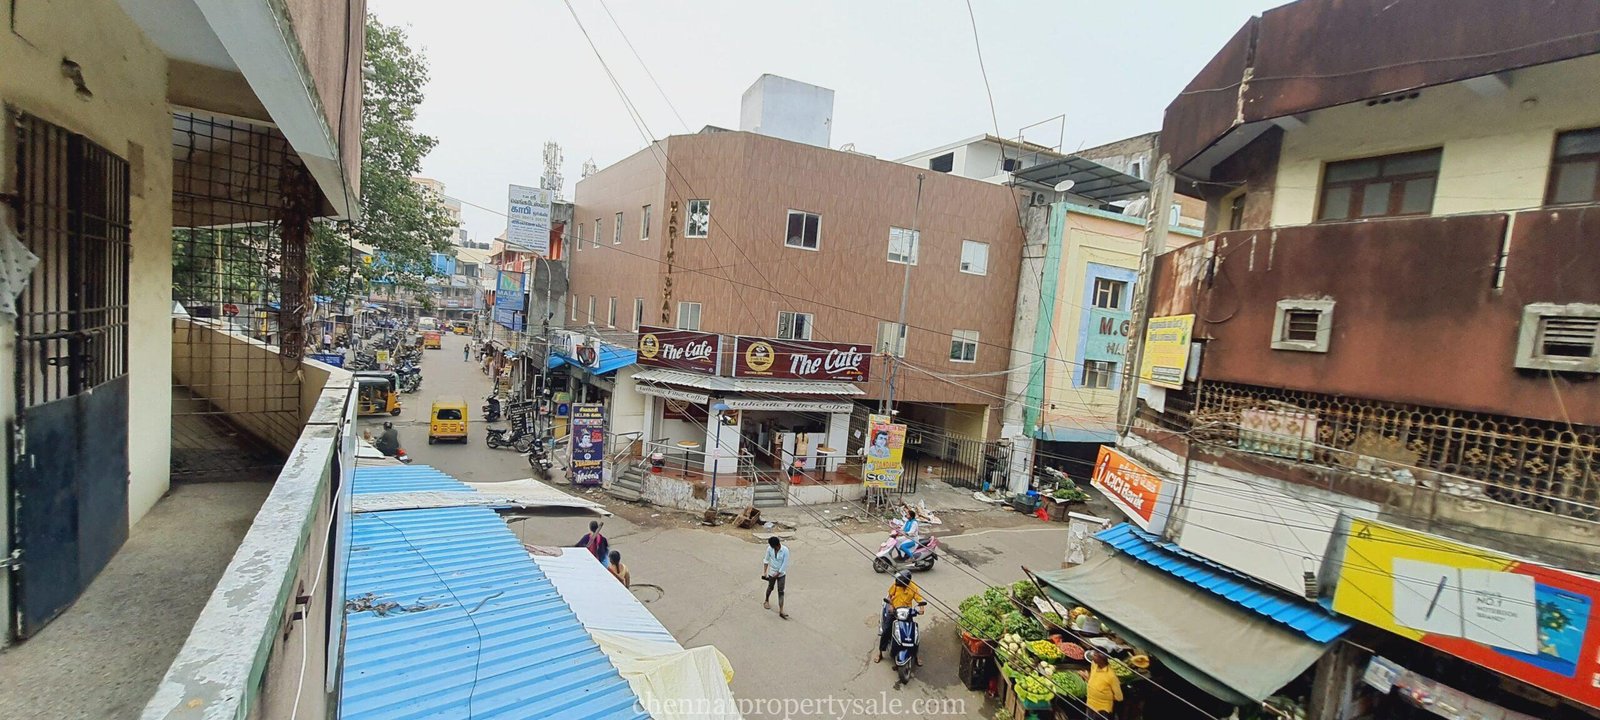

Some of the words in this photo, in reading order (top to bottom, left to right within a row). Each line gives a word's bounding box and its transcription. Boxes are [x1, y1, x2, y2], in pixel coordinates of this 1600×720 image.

[663, 343, 684, 360] The
[685, 340, 713, 358] Cafe
[790, 353, 822, 375] The
[824, 346, 864, 371] Cafe
[686, 393, 708, 402] Coffee
[818, 403, 852, 411] Coffee
[1104, 470, 1124, 494] ICICI
[1121, 484, 1144, 510] Bank
